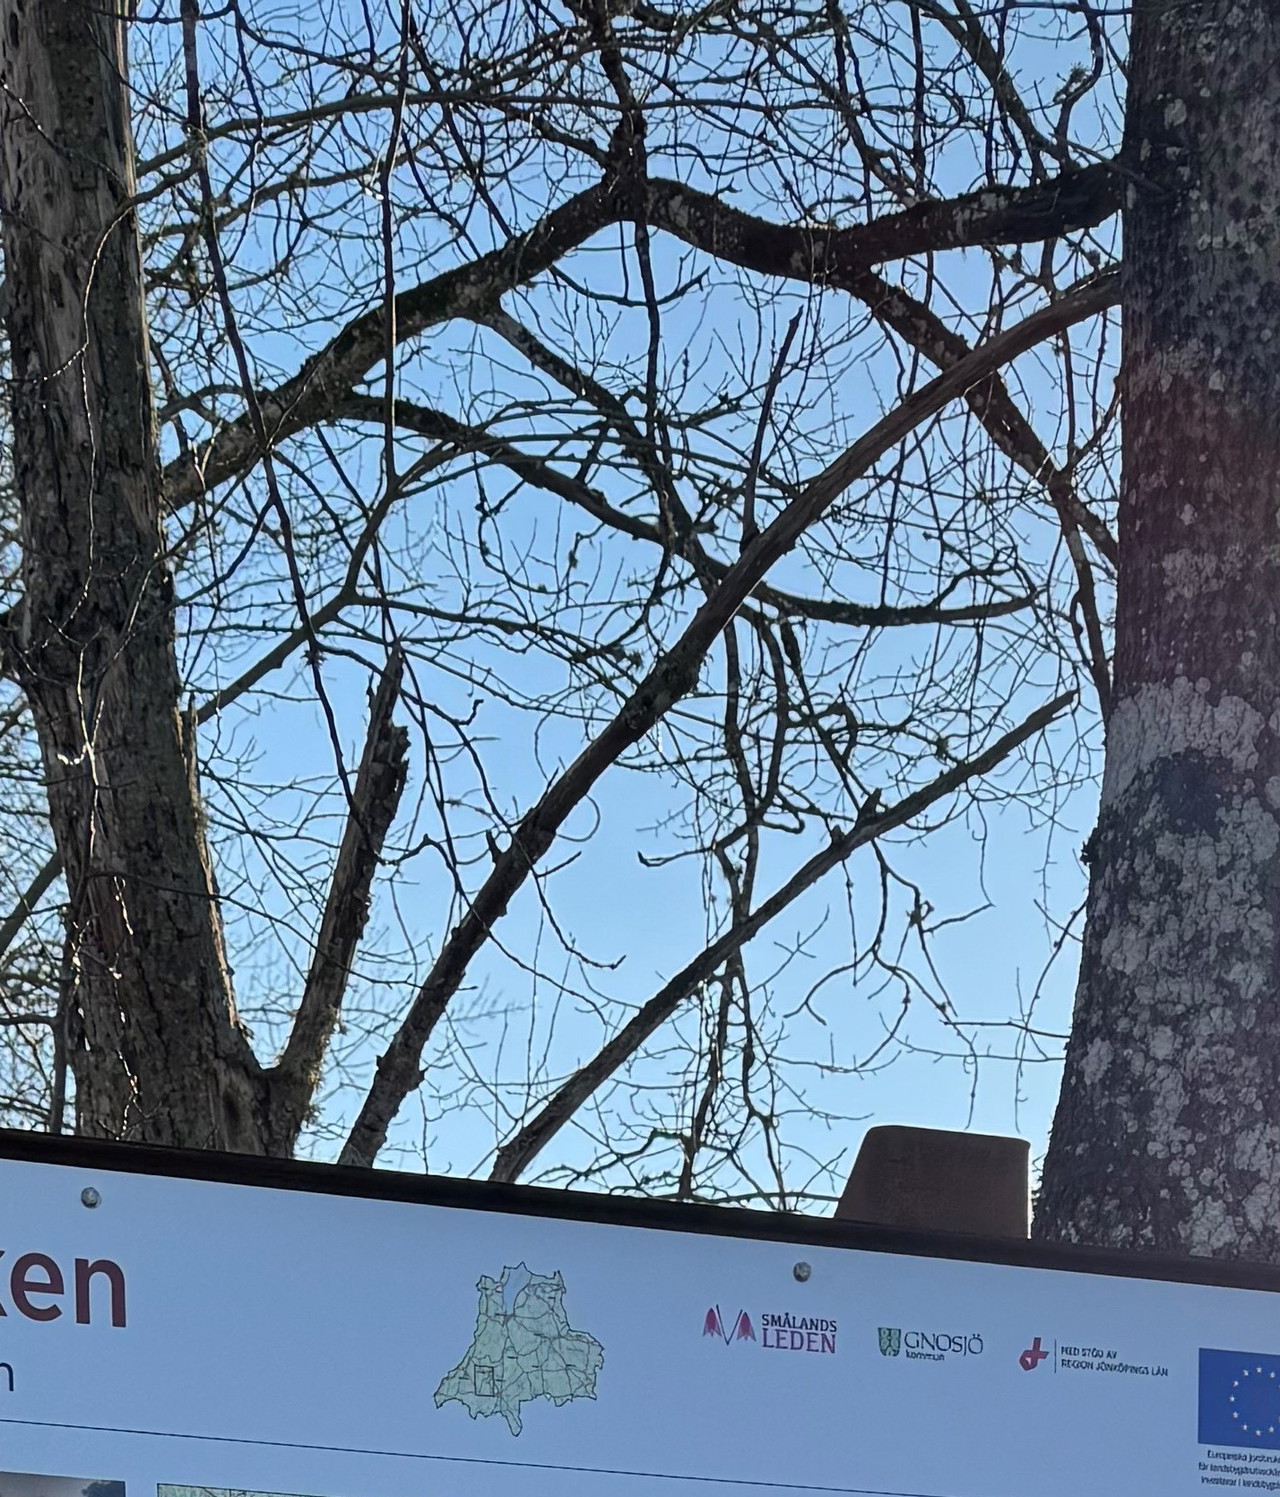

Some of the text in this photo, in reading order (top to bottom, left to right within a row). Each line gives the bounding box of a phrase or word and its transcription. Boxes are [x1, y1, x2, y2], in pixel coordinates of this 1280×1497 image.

[760, 1310, 838, 1334] SMÅLANDS
[760, 1325, 837, 1355] LEDEN
[903, 1330, 984, 1358] GNOSJÖ
